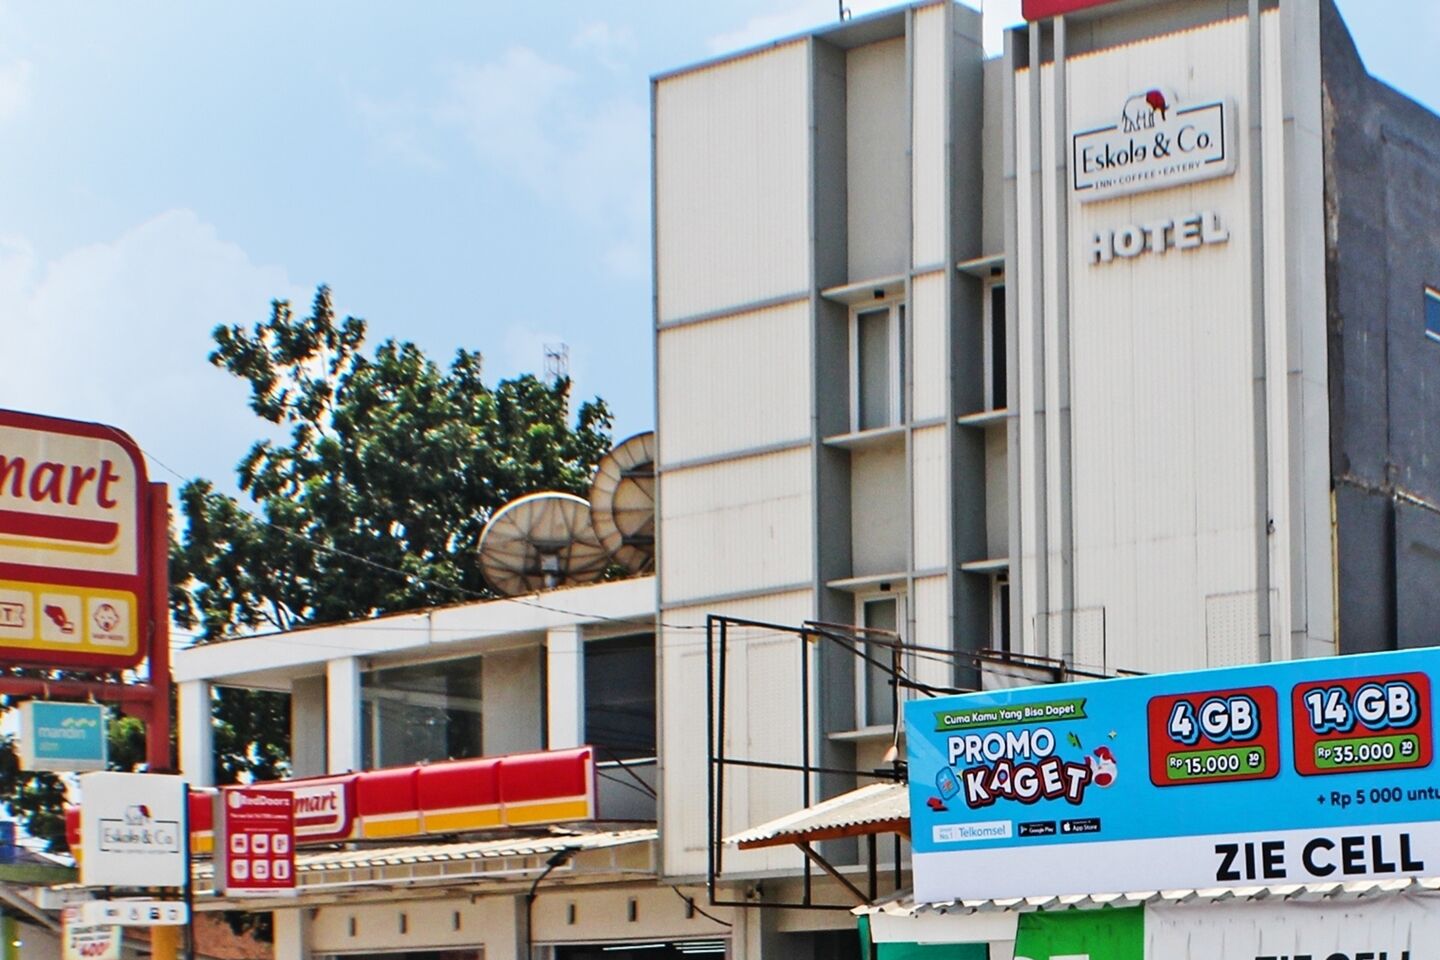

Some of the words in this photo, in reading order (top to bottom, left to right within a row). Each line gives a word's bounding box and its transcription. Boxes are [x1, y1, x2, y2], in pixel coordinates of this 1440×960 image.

[1152, 132, 1171, 159] &
[1177, 125, 1214, 153] Co.
[1118, 171, 1155, 185] COFFEE
[1163, 161, 1201, 176] EATERY
[1089, 211, 1230, 264] HOTEL
[944, 714, 970, 725] Cuma
[972, 712, 998, 722] Kamu
[1000, 709, 1022, 721] Yang
[1025, 707, 1044, 717] Bisa
[1046, 704, 1075, 716] Dapet
[1171, 705, 1192, 736] 4
[1202, 700, 1252, 734] GB
[1307, 691, 1347, 725] 14
[1357, 686, 1411, 720] GB
[948, 728, 1056, 765] PROMO
[1317, 747, 1332, 758] Rp
[1333, 743, 1394, 762] 35.000
[1169, 757, 1183, 768] Rp
[1185, 755, 1239, 773] 15.000
[964, 759, 1088, 803] KAGET
[1330, 791, 1351, 809] Rp
[1356, 790, 1366, 805] 5
[1370, 787, 1402, 804] 000
[958, 825, 1007, 839] Telkomsel
[1084, 823, 1098, 831] Store
[1214, 841, 1287, 881] ZIE
[1301, 833, 1424, 877] CELL
